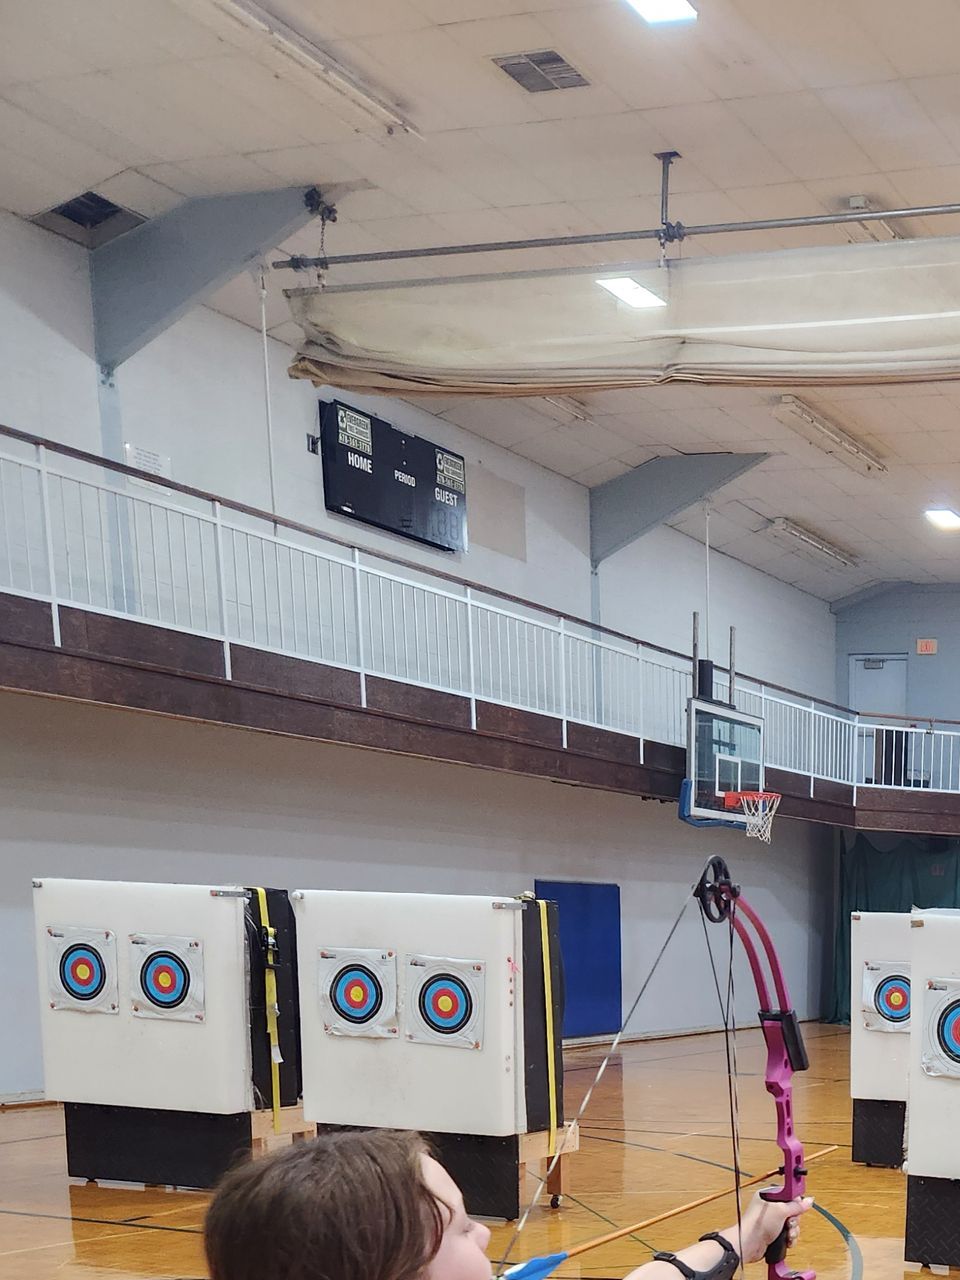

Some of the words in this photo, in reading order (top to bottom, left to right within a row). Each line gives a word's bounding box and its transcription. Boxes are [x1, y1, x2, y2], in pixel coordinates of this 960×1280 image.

[348, 451, 373, 474] HOME
[394, 470, 416, 487] PERIOD
[434, 487, 458, 507] GUEST
